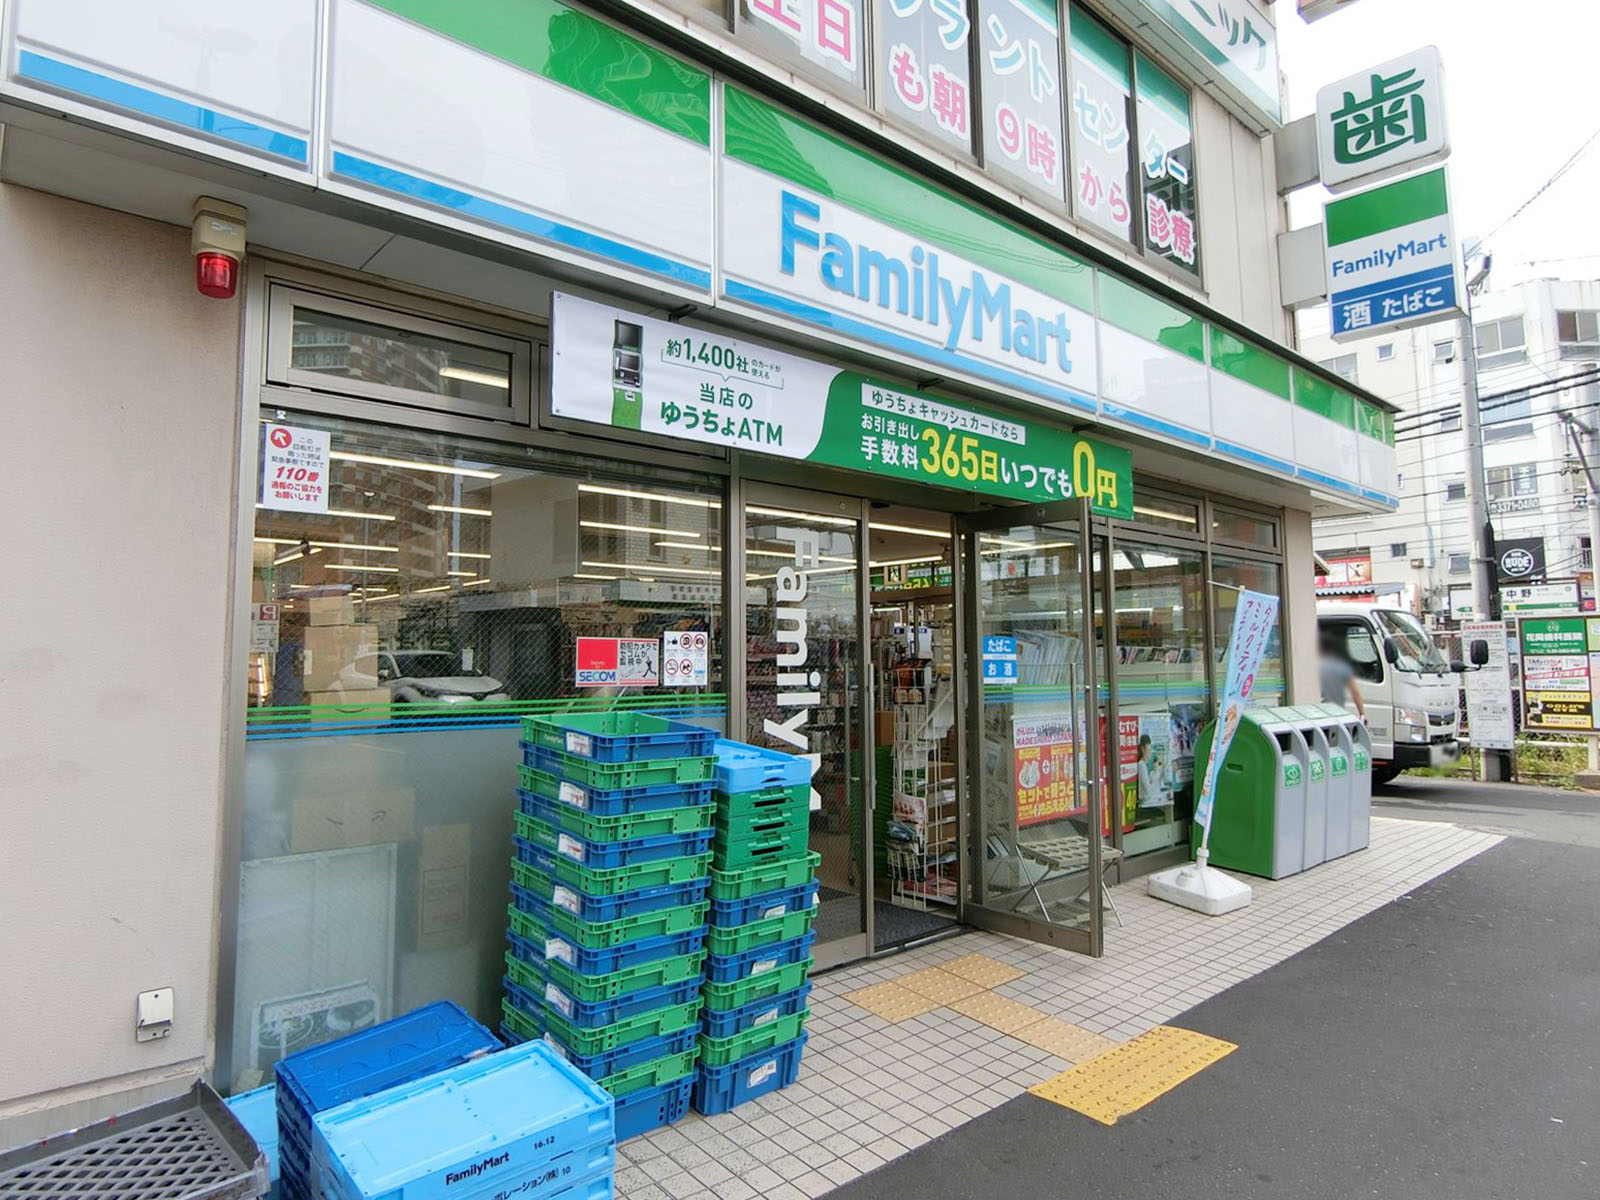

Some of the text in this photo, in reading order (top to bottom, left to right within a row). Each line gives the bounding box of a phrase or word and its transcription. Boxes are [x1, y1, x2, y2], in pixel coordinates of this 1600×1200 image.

[1330, 68, 1428, 164] 歯
[1333, 233, 1447, 277] FamilyMart
[779, 190, 1074, 375] FamilyMart
[1343, 286, 1444, 330] 酒 たばこ
[666, 338, 749, 374] 約1,400社
[700, 383, 753, 410] 当店の
[660, 401, 783, 446] ゆうちょATM
[861, 413, 920, 441] お引き出し
[872, 390, 1018, 440] ゆうちょキャッシュカードなら
[861, 436, 918, 470] 手数料
[988, 639, 1012, 652] たばこ
[579, 671, 616, 682] SECOM
[534, 1136, 555, 1150] 16.12
[445, 1152, 510, 1185] FamilyMart
